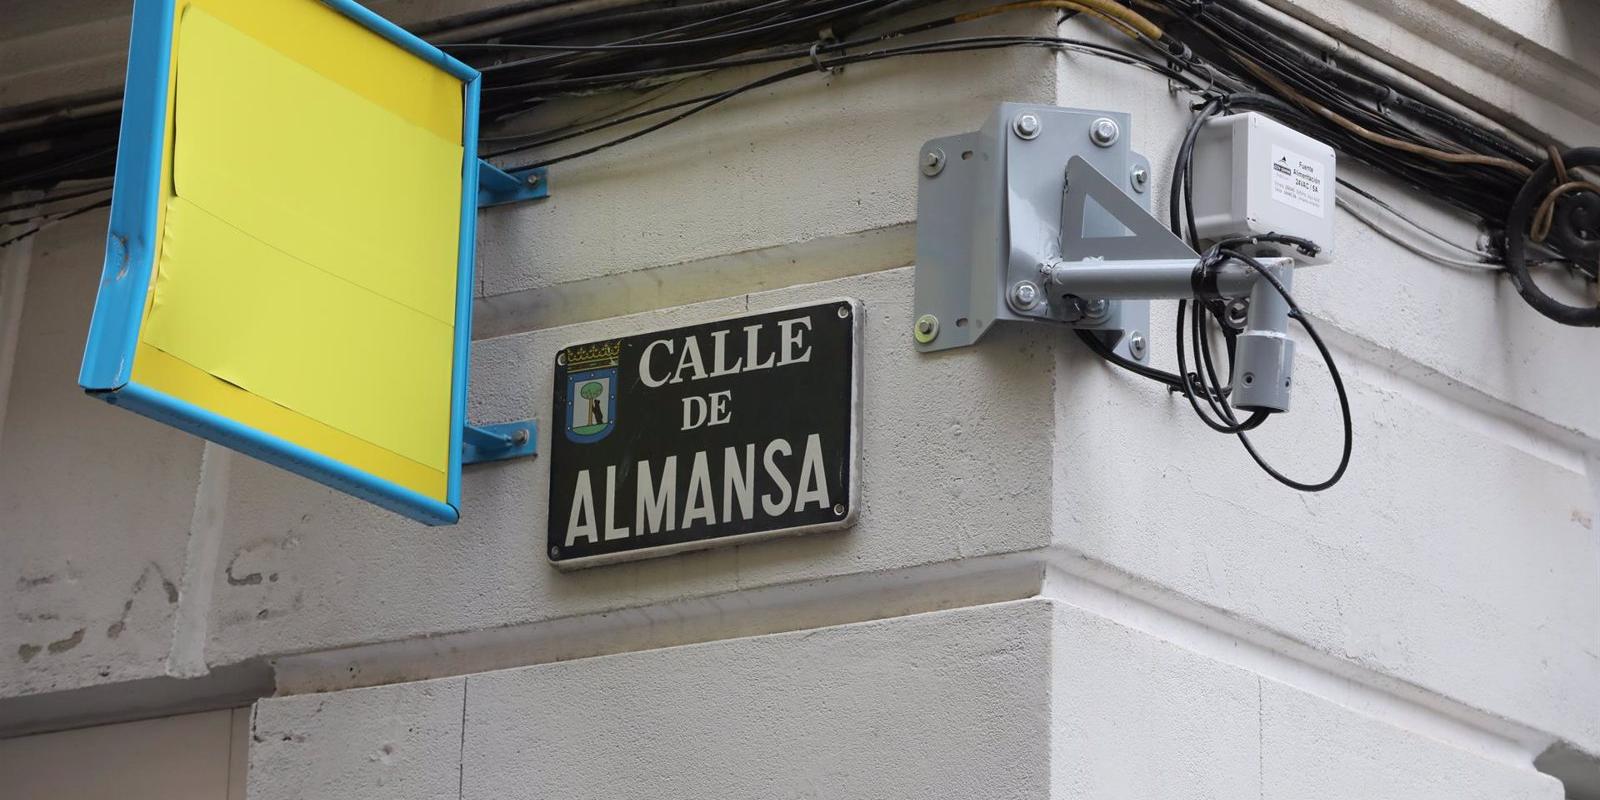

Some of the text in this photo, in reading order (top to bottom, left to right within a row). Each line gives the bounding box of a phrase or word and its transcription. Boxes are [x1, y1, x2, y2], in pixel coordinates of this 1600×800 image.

[639, 316, 812, 388] CALLE
[681, 390, 732, 430] DE
[564, 433, 830, 547] ALMANSA
